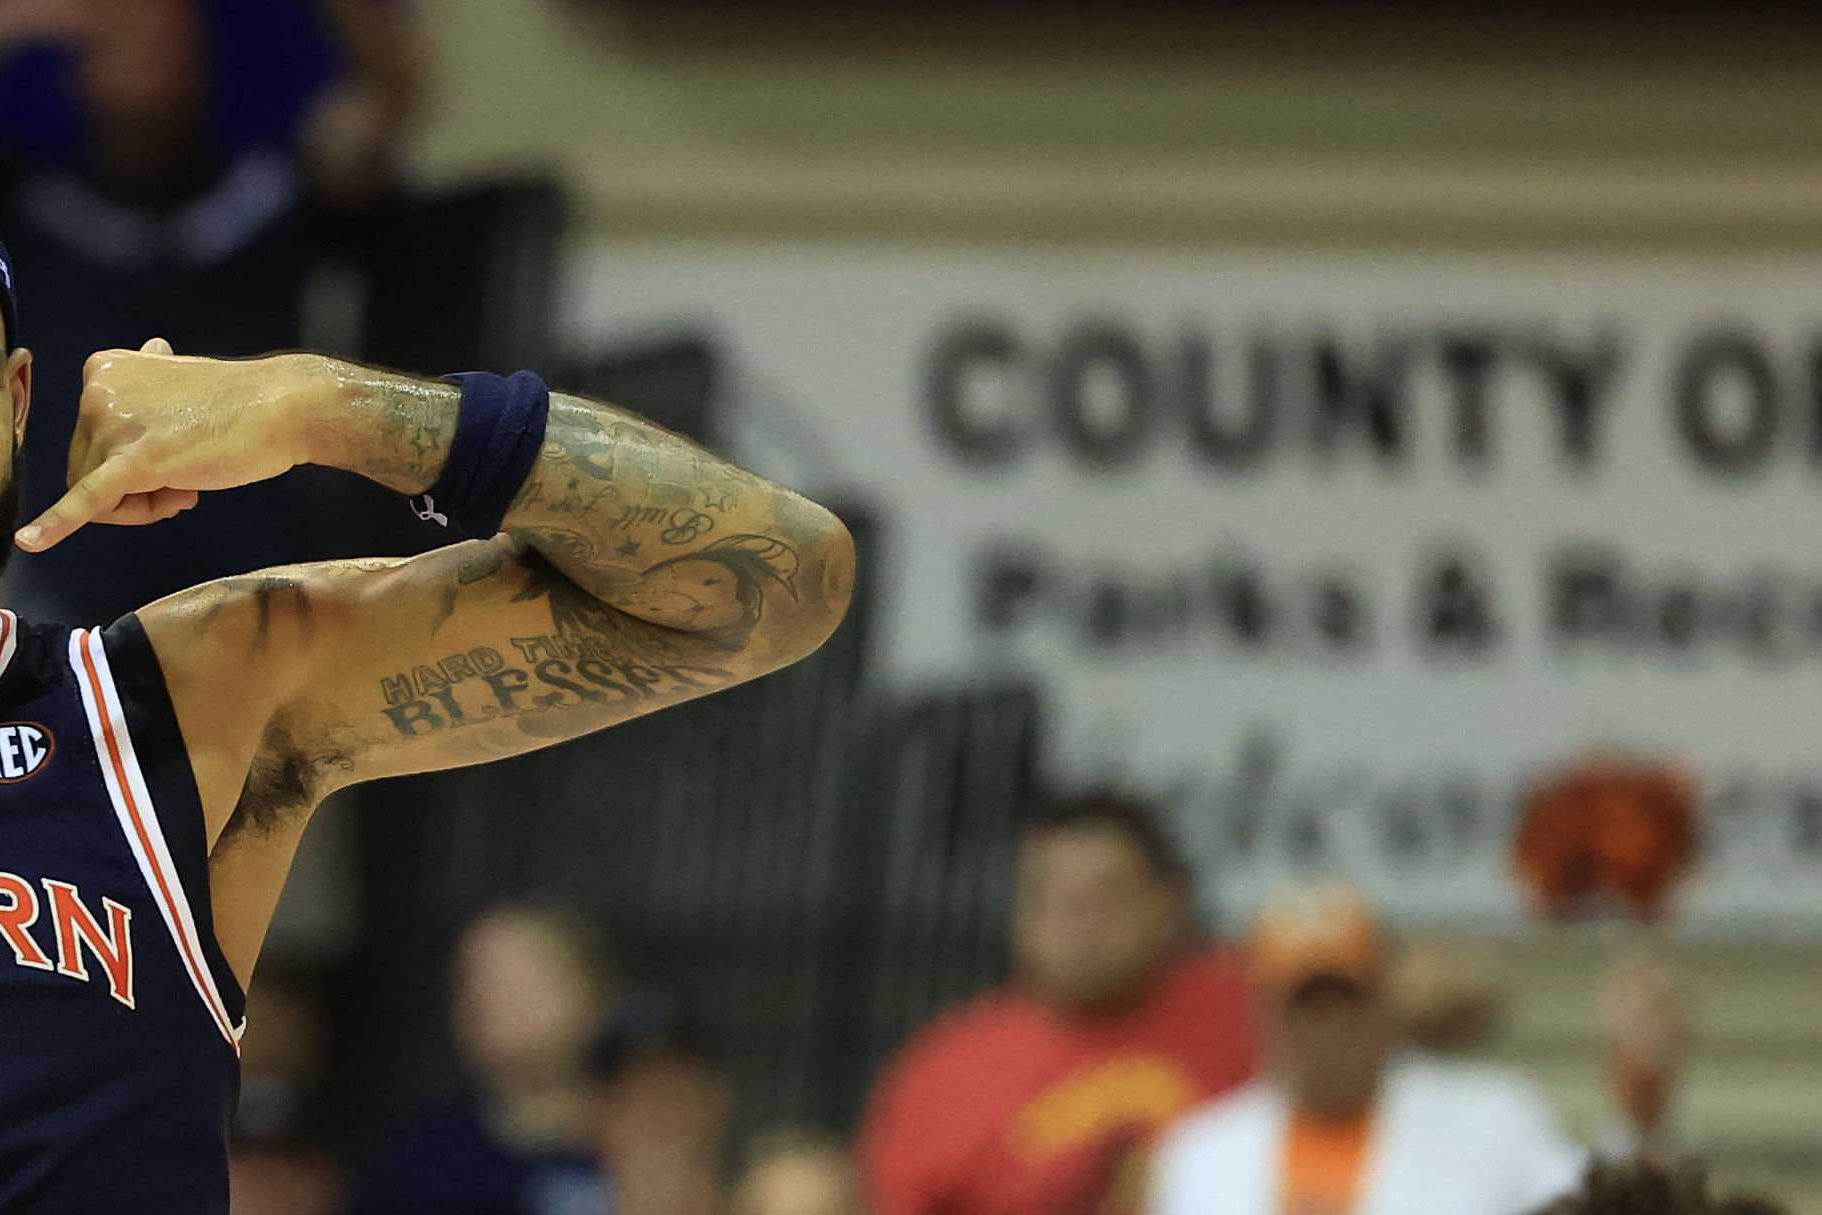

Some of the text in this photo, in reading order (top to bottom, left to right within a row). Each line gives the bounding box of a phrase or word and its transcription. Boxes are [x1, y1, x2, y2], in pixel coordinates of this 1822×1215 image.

[920, 318, 1822, 486] COUNTY O
[978, 542, 1370, 656] Parks
[381, 646, 504, 706] HARD
